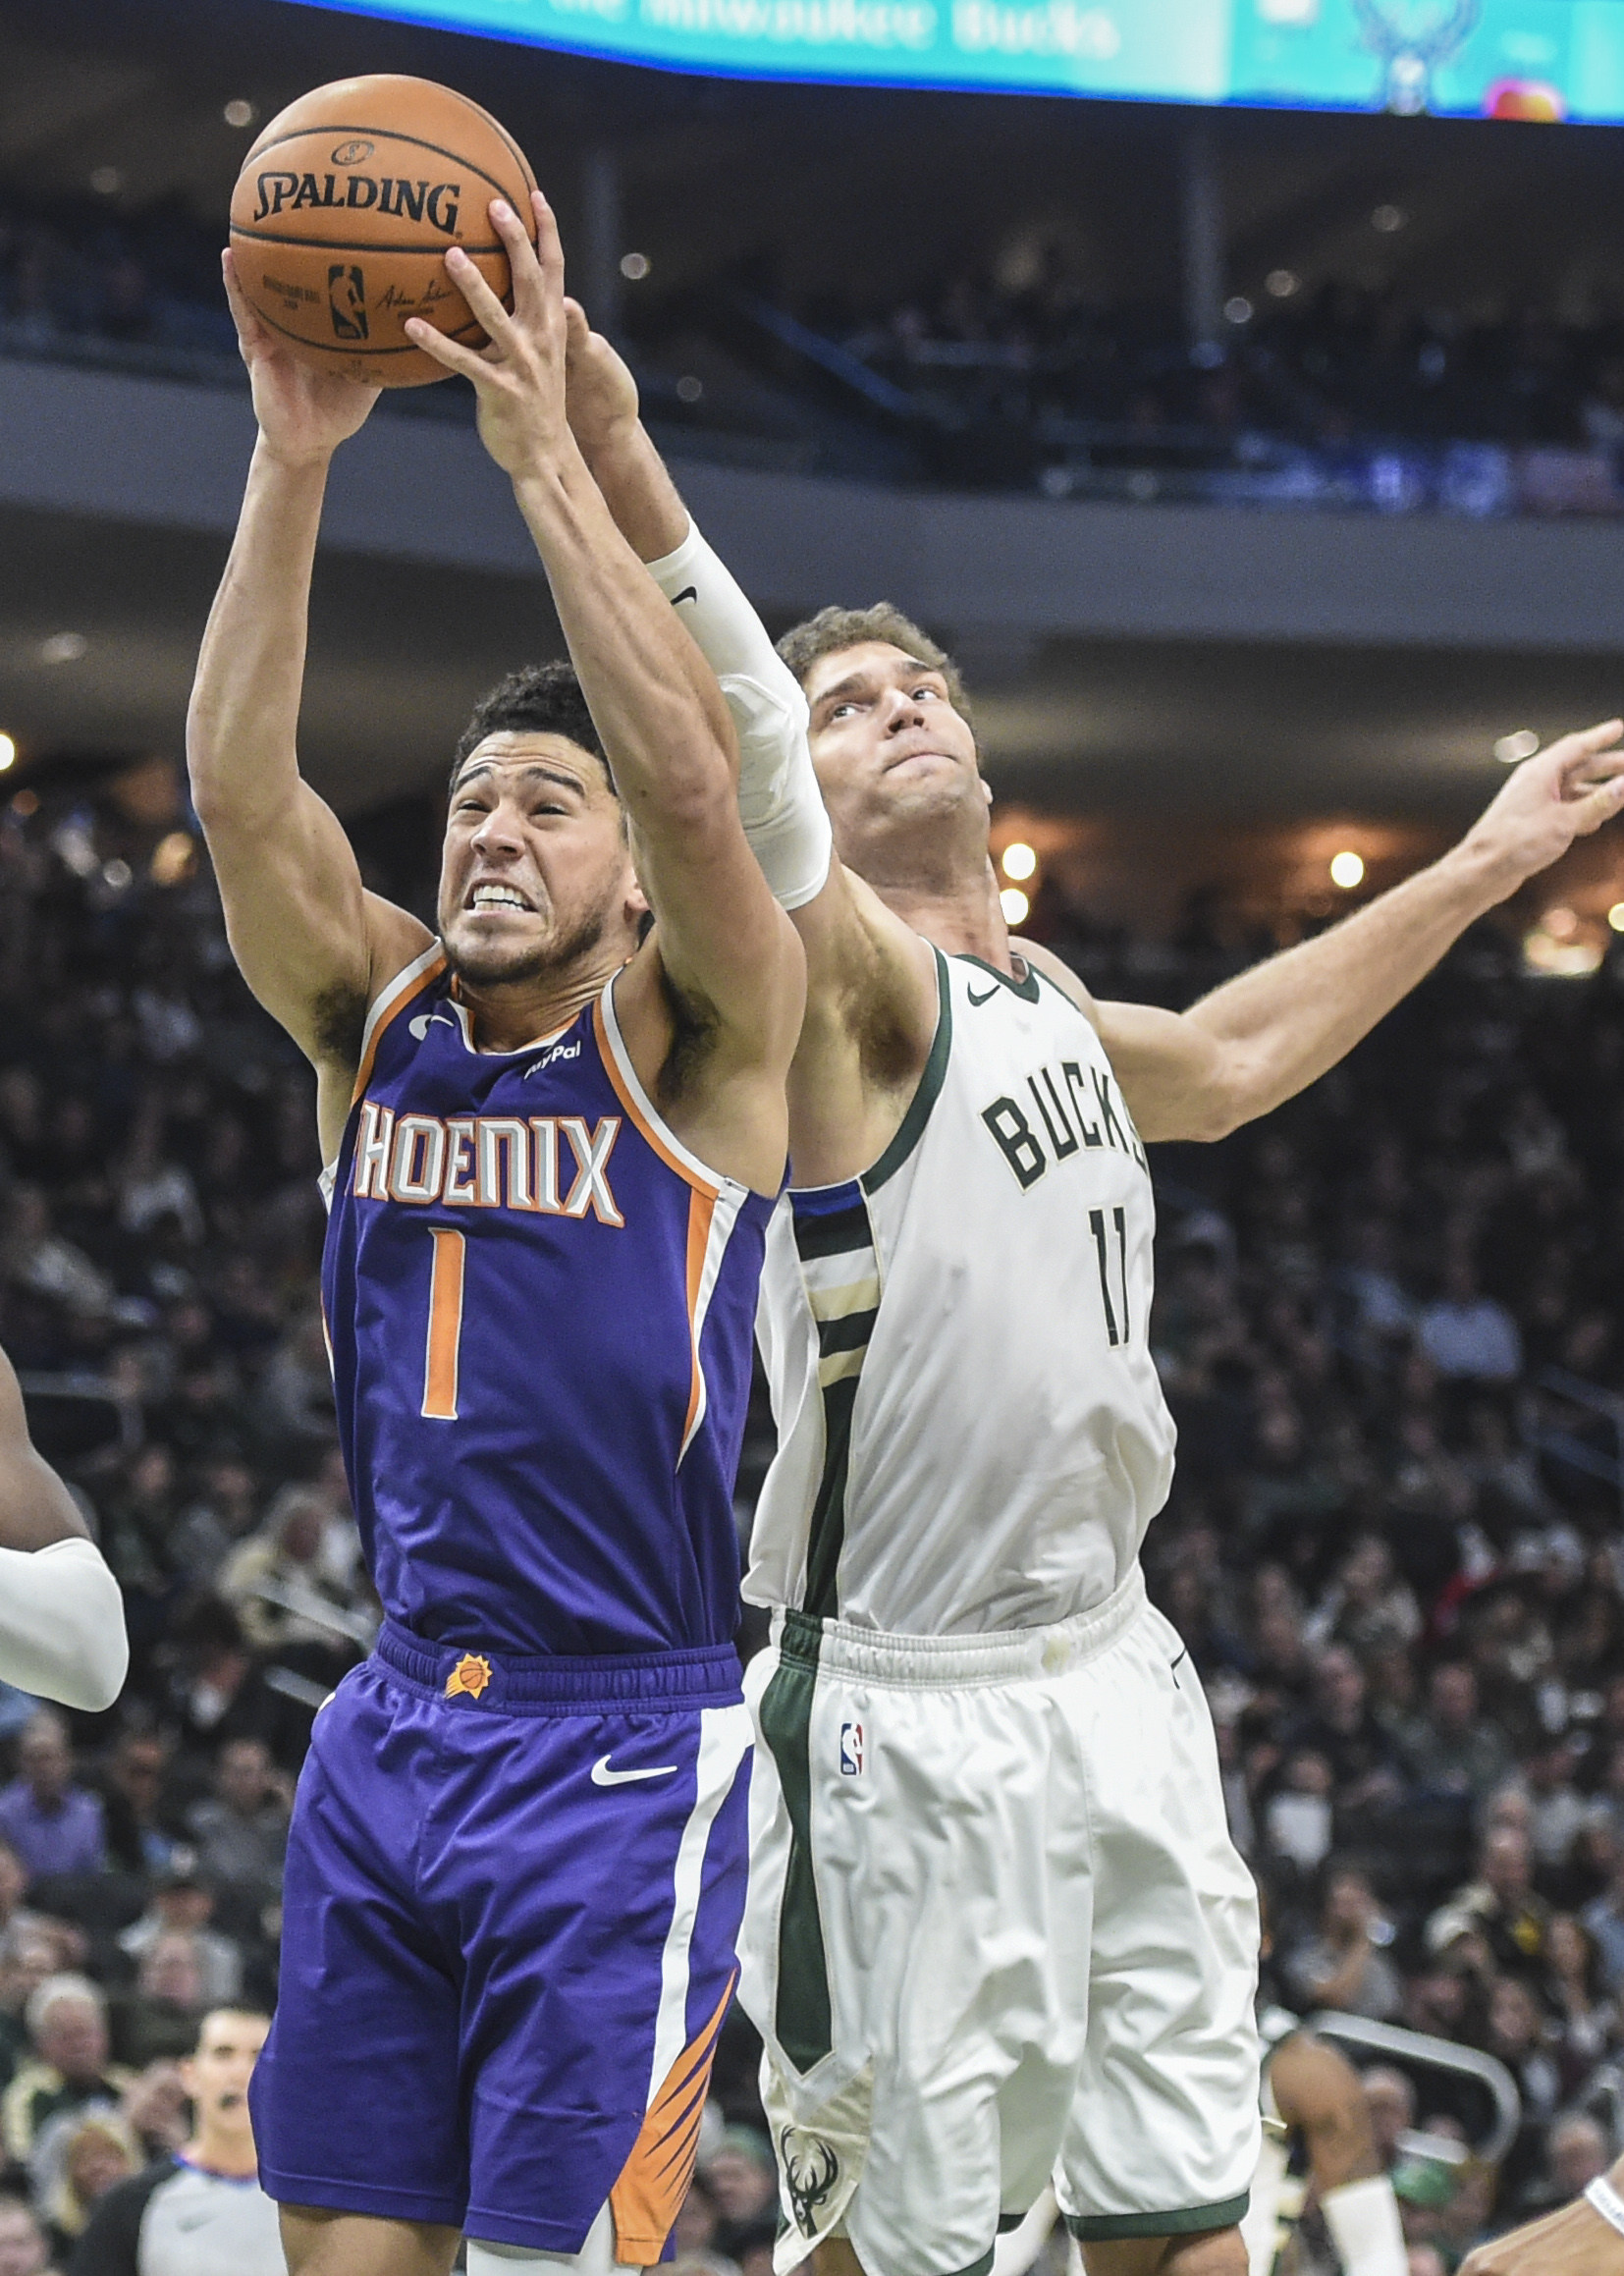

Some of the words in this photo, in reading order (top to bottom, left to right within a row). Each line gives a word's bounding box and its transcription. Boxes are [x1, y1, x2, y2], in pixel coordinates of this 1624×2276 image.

[253, 172, 460, 236] SPALDING
[353, 1100, 625, 1228] HOENIX
[420, 1226, 466, 1421] 1
[1088, 1204, 1131, 1350] 11
